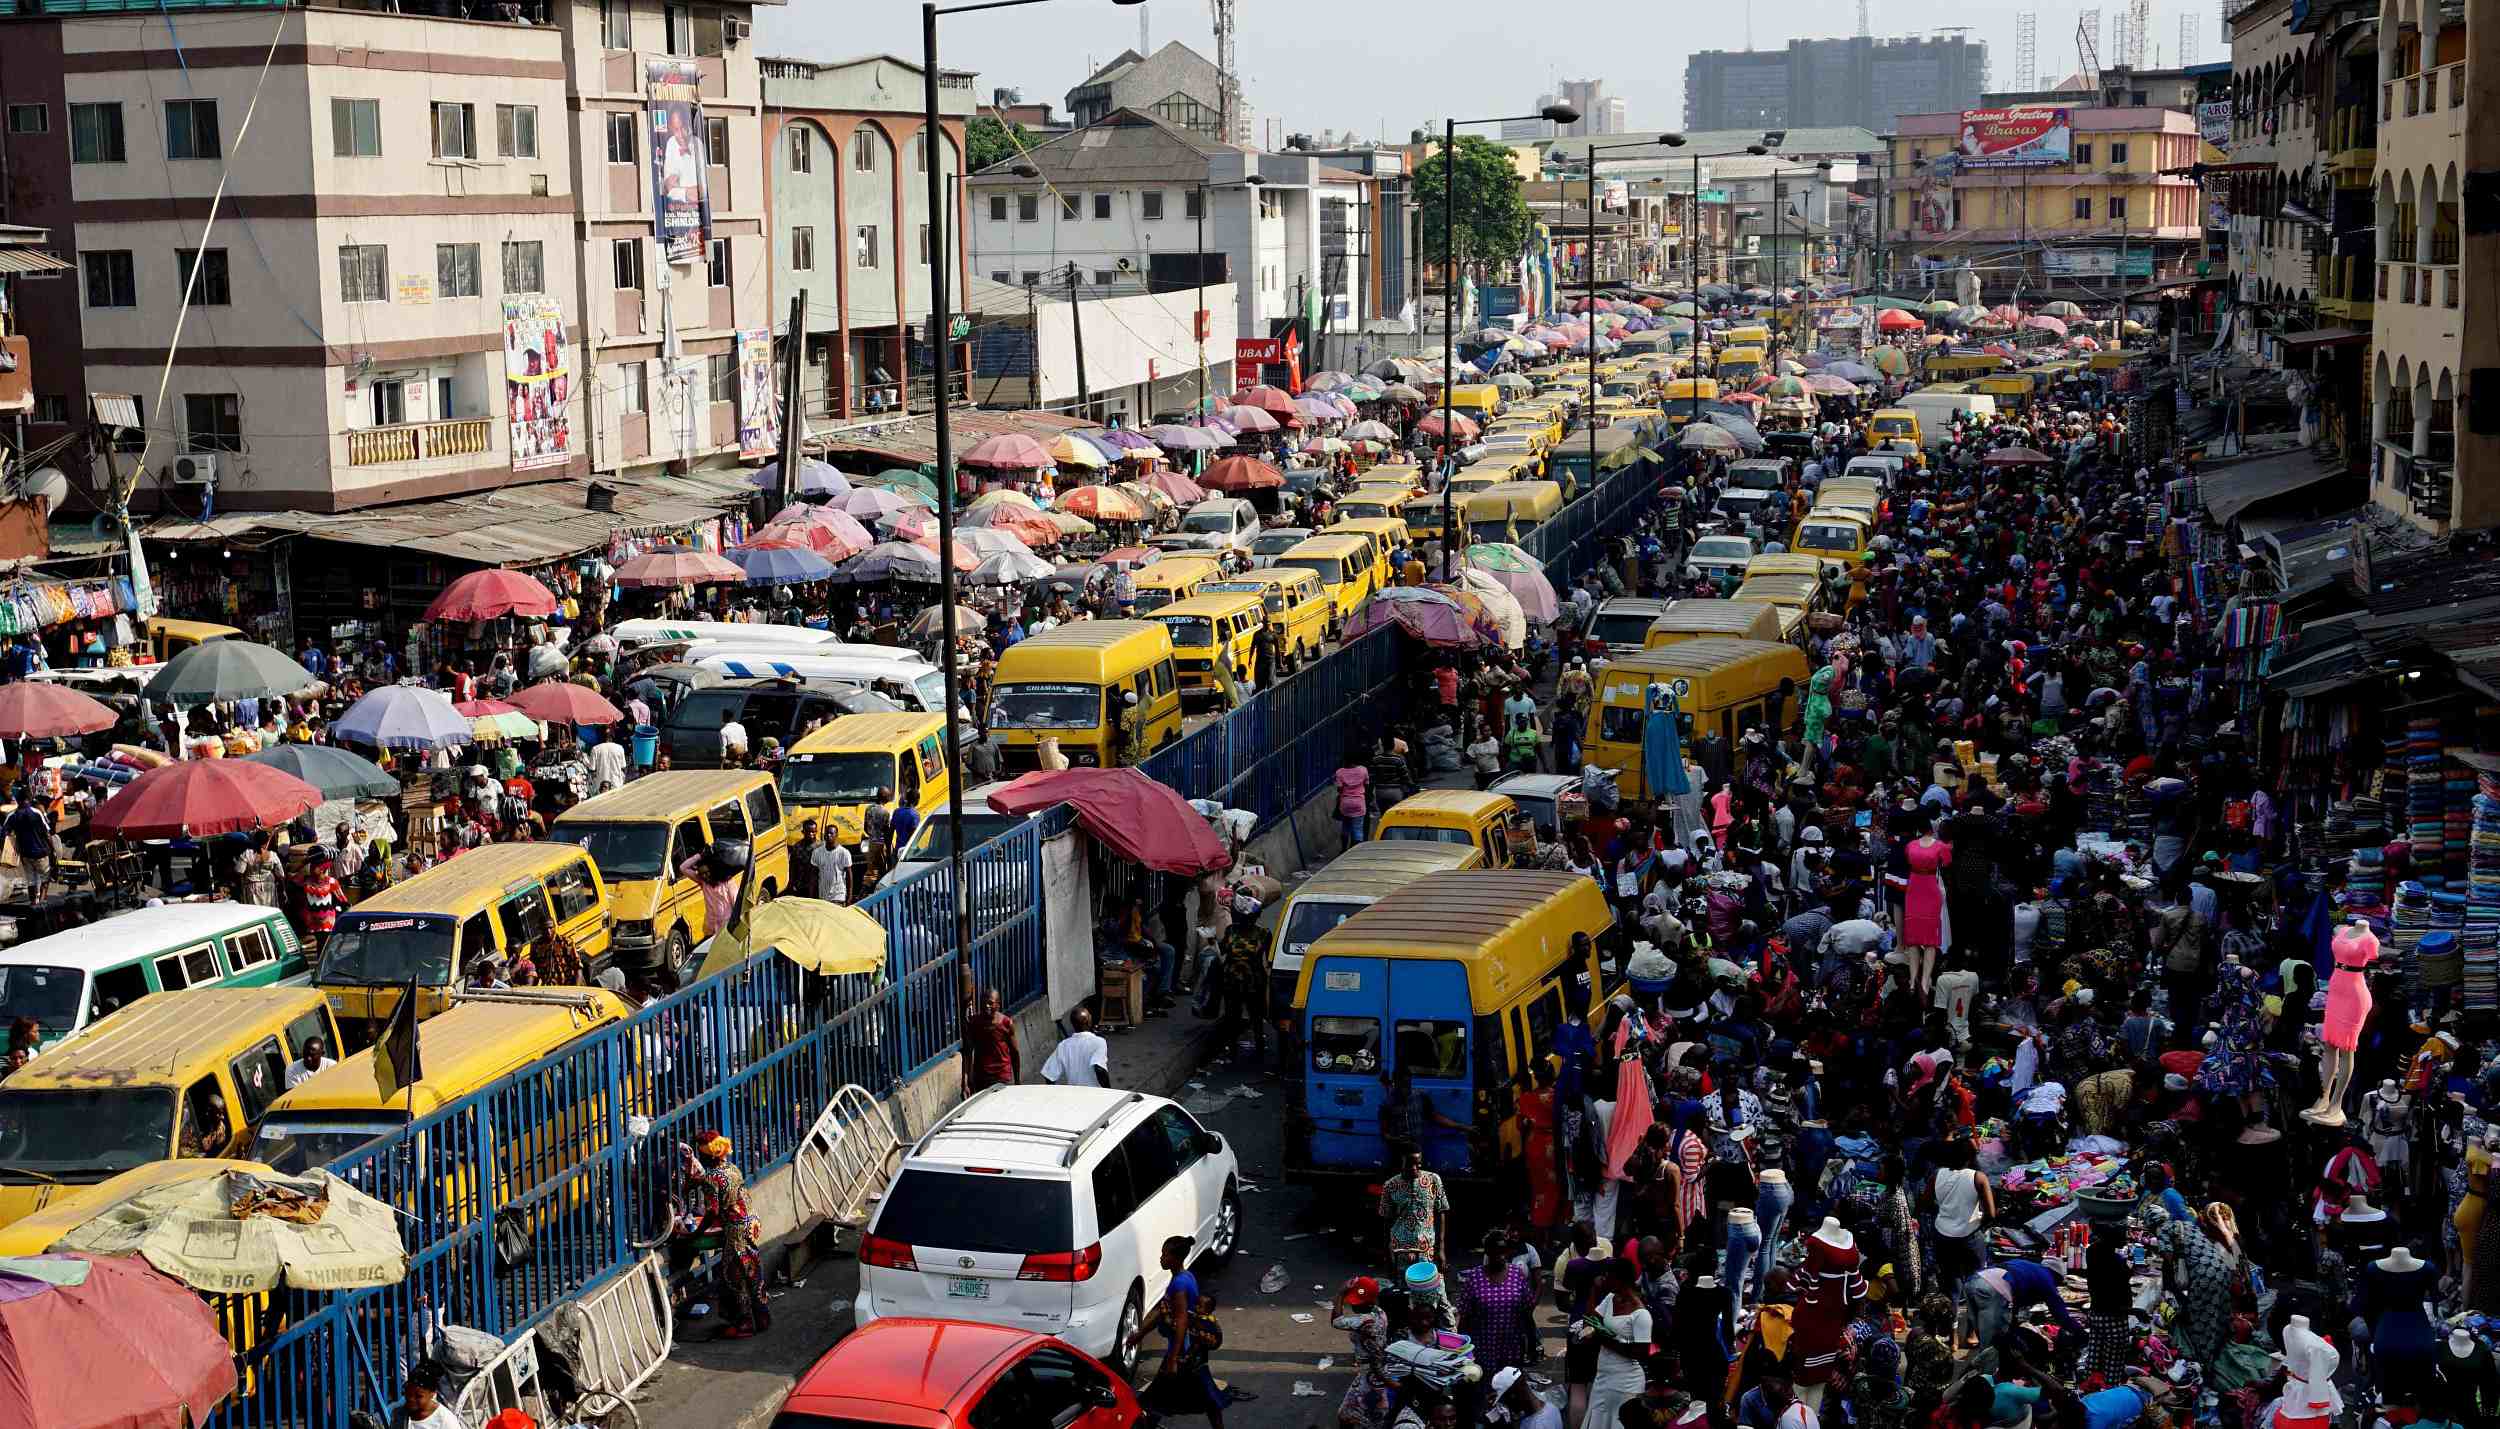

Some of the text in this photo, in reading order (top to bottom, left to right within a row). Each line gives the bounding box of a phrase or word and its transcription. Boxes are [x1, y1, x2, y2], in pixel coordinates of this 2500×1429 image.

[1962, 109, 2054, 123] Seasons Greeting
[1984, 124, 2037, 136] Brasas
[1238, 348, 1262, 358] UBA
[1238, 377, 1256, 385] ATM
[304, 1265, 385, 1283] THINK BIG
[222, 1274, 255, 1289] BIG
